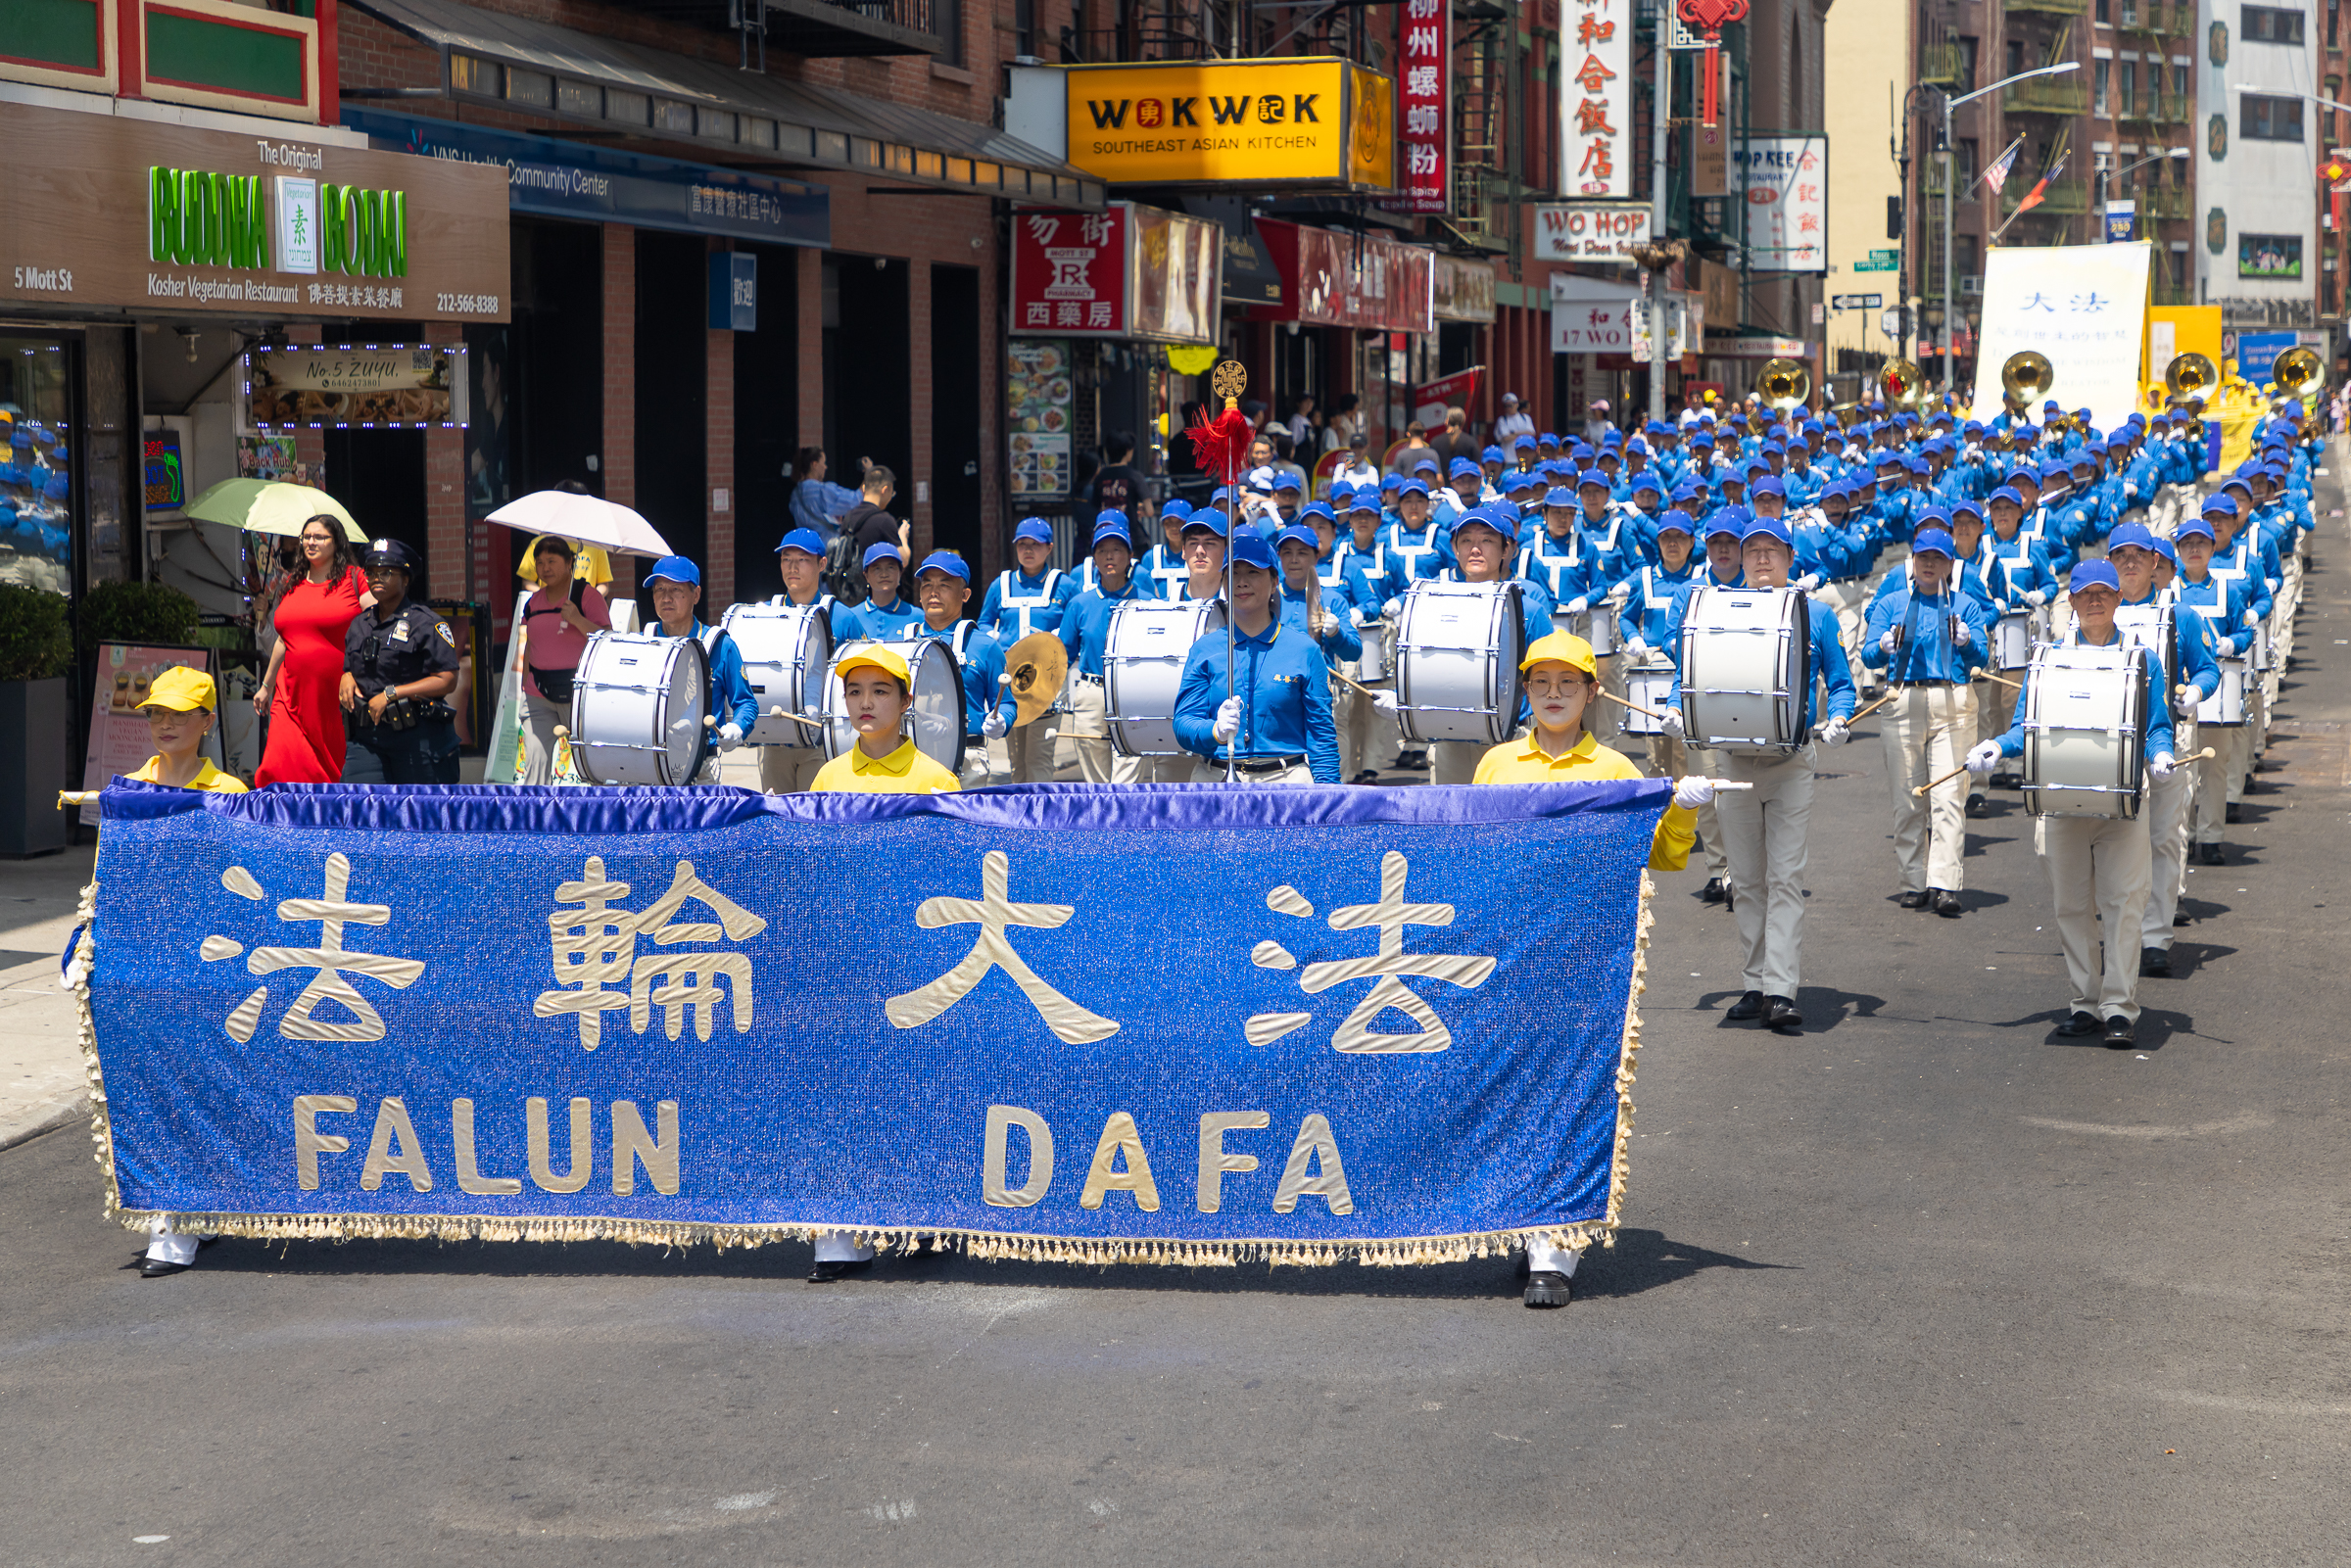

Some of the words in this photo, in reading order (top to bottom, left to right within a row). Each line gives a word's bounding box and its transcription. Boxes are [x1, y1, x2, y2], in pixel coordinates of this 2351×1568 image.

[1574, 0, 1616, 180] 和合飯店
[258, 140, 278, 165] The
[280, 144, 322, 173] Original
[1093, 139, 1186, 154] SOUTHEAST
[1191, 137, 1239, 151] ASIAN
[1248, 136, 1317, 149] KITCHEN
[1766, 151, 1794, 167] KEE
[506, 158, 570, 196] Community
[573, 168, 609, 196] Center
[286, 186, 312, 201] Vegetarian
[149, 166, 269, 270] BUDDHA
[291, 204, 309, 246] 素
[320, 183, 408, 278] BODAI
[1544, 212, 1586, 235] WO
[1596, 212, 1645, 237] HOP
[15, 266, 23, 288] 5
[25, 266, 57, 291] Mott
[59, 268, 72, 292] St
[148, 273, 185, 298] Kosher
[187, 275, 243, 304] Vegetarian
[245, 279, 299, 304] Restaurant
[437, 293, 499, 313] 212-566-8388
[1027, 301, 1113, 328] 西藥房
[2020, 292, 2110, 312] 大法
[1562, 330, 1580, 345] 17
[1587, 330, 1621, 345] WO
[306, 361, 343, 378] No.5
[331, 378, 381, 388] 6462473801
[249, 454, 270, 469] Back
[272, 454, 291, 469] Rub
[293, 1094, 680, 1197] FALUN
[983, 1104, 1354, 1215] DAFA
